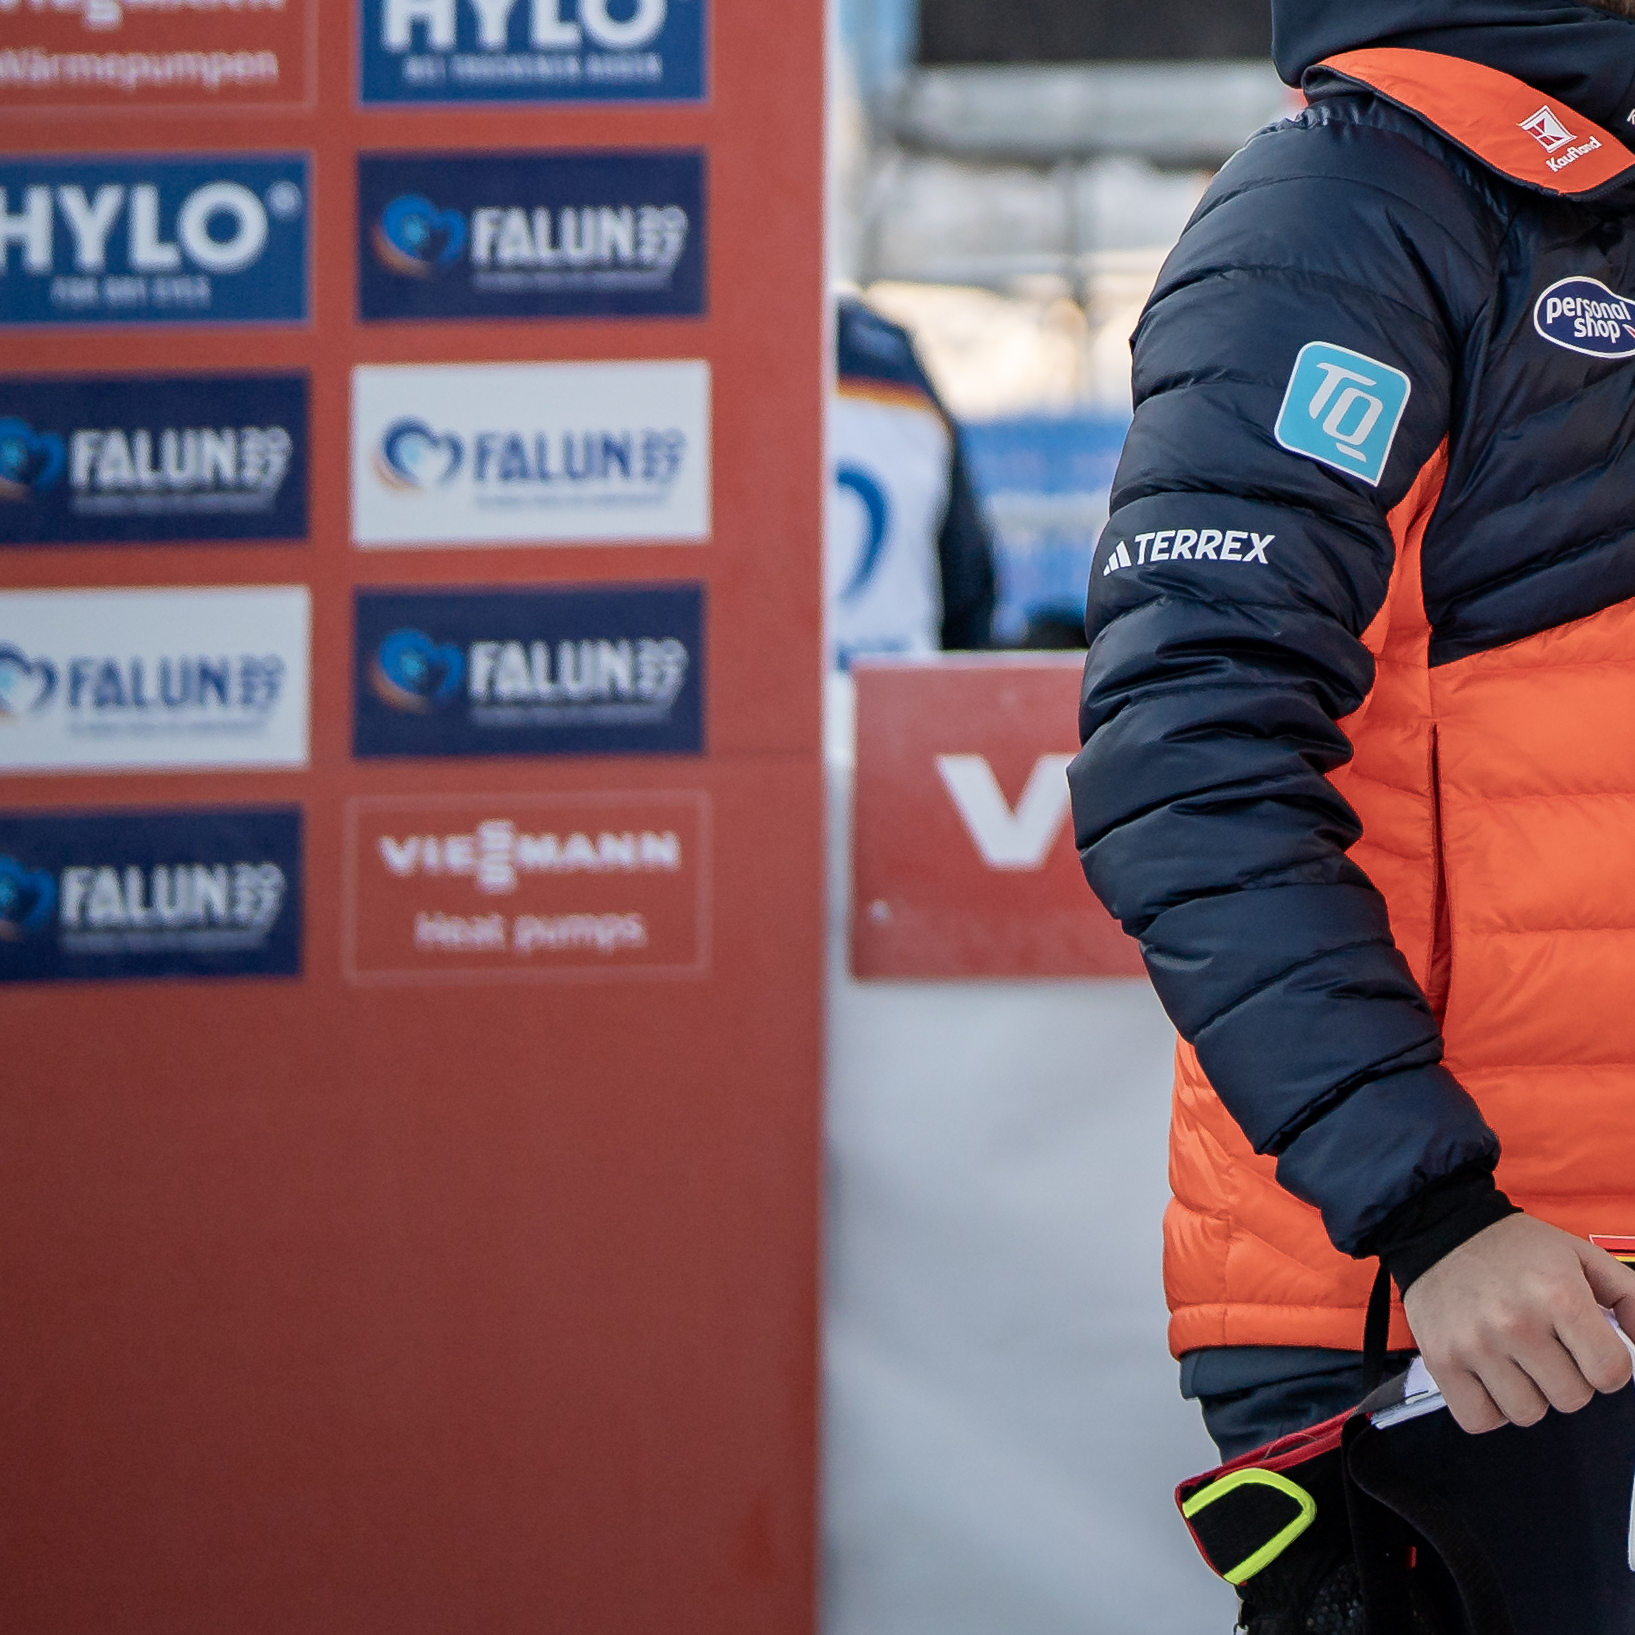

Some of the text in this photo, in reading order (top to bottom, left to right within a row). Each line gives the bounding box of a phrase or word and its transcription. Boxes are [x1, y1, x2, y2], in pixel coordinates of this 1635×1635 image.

[1546, 136, 1602, 172] Kaufland
[1546, 295, 1632, 326] personal
[1573, 317, 1622, 344] shop
[1134, 528, 1276, 565] TERREX
